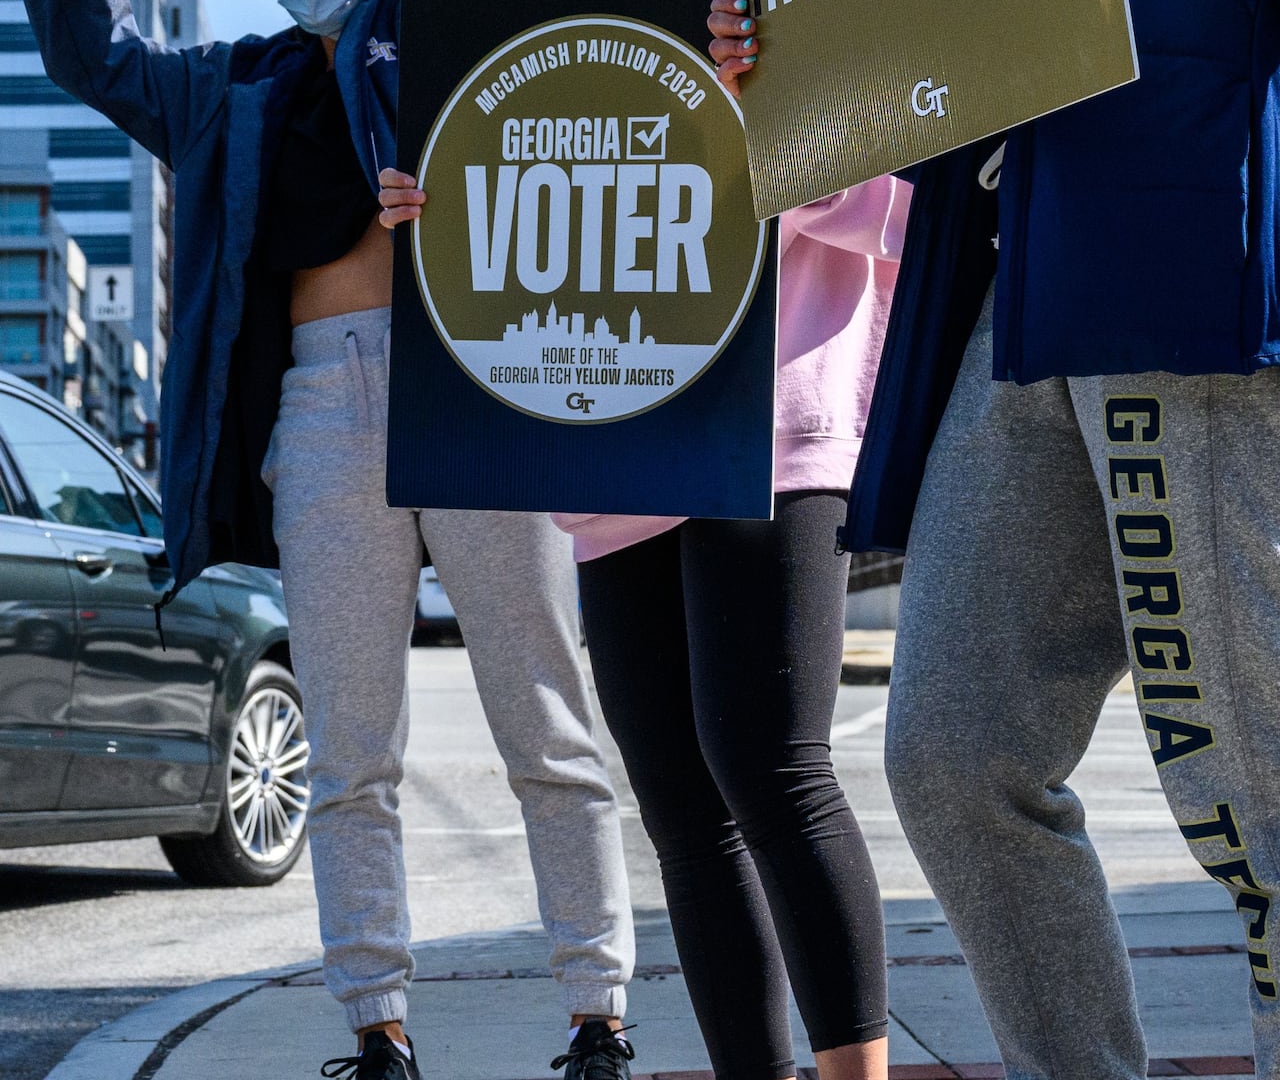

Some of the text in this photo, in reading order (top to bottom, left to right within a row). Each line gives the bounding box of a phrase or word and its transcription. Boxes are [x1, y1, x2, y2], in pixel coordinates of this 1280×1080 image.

[575, 38, 662, 78] PAVILION
[658, 62, 707, 111] 2020
[911, 76, 950, 120] GT
[501, 116, 621, 162] GEORGIA
[464, 162, 713, 294] VOTER
[489, 366, 675, 387] GEORGIA TECH YELLOW JACKETS
[541, 346, 619, 366] HOME OF THE
[565, 391, 596, 414] GT
[1103, 394, 1216, 770] GEORGIA
